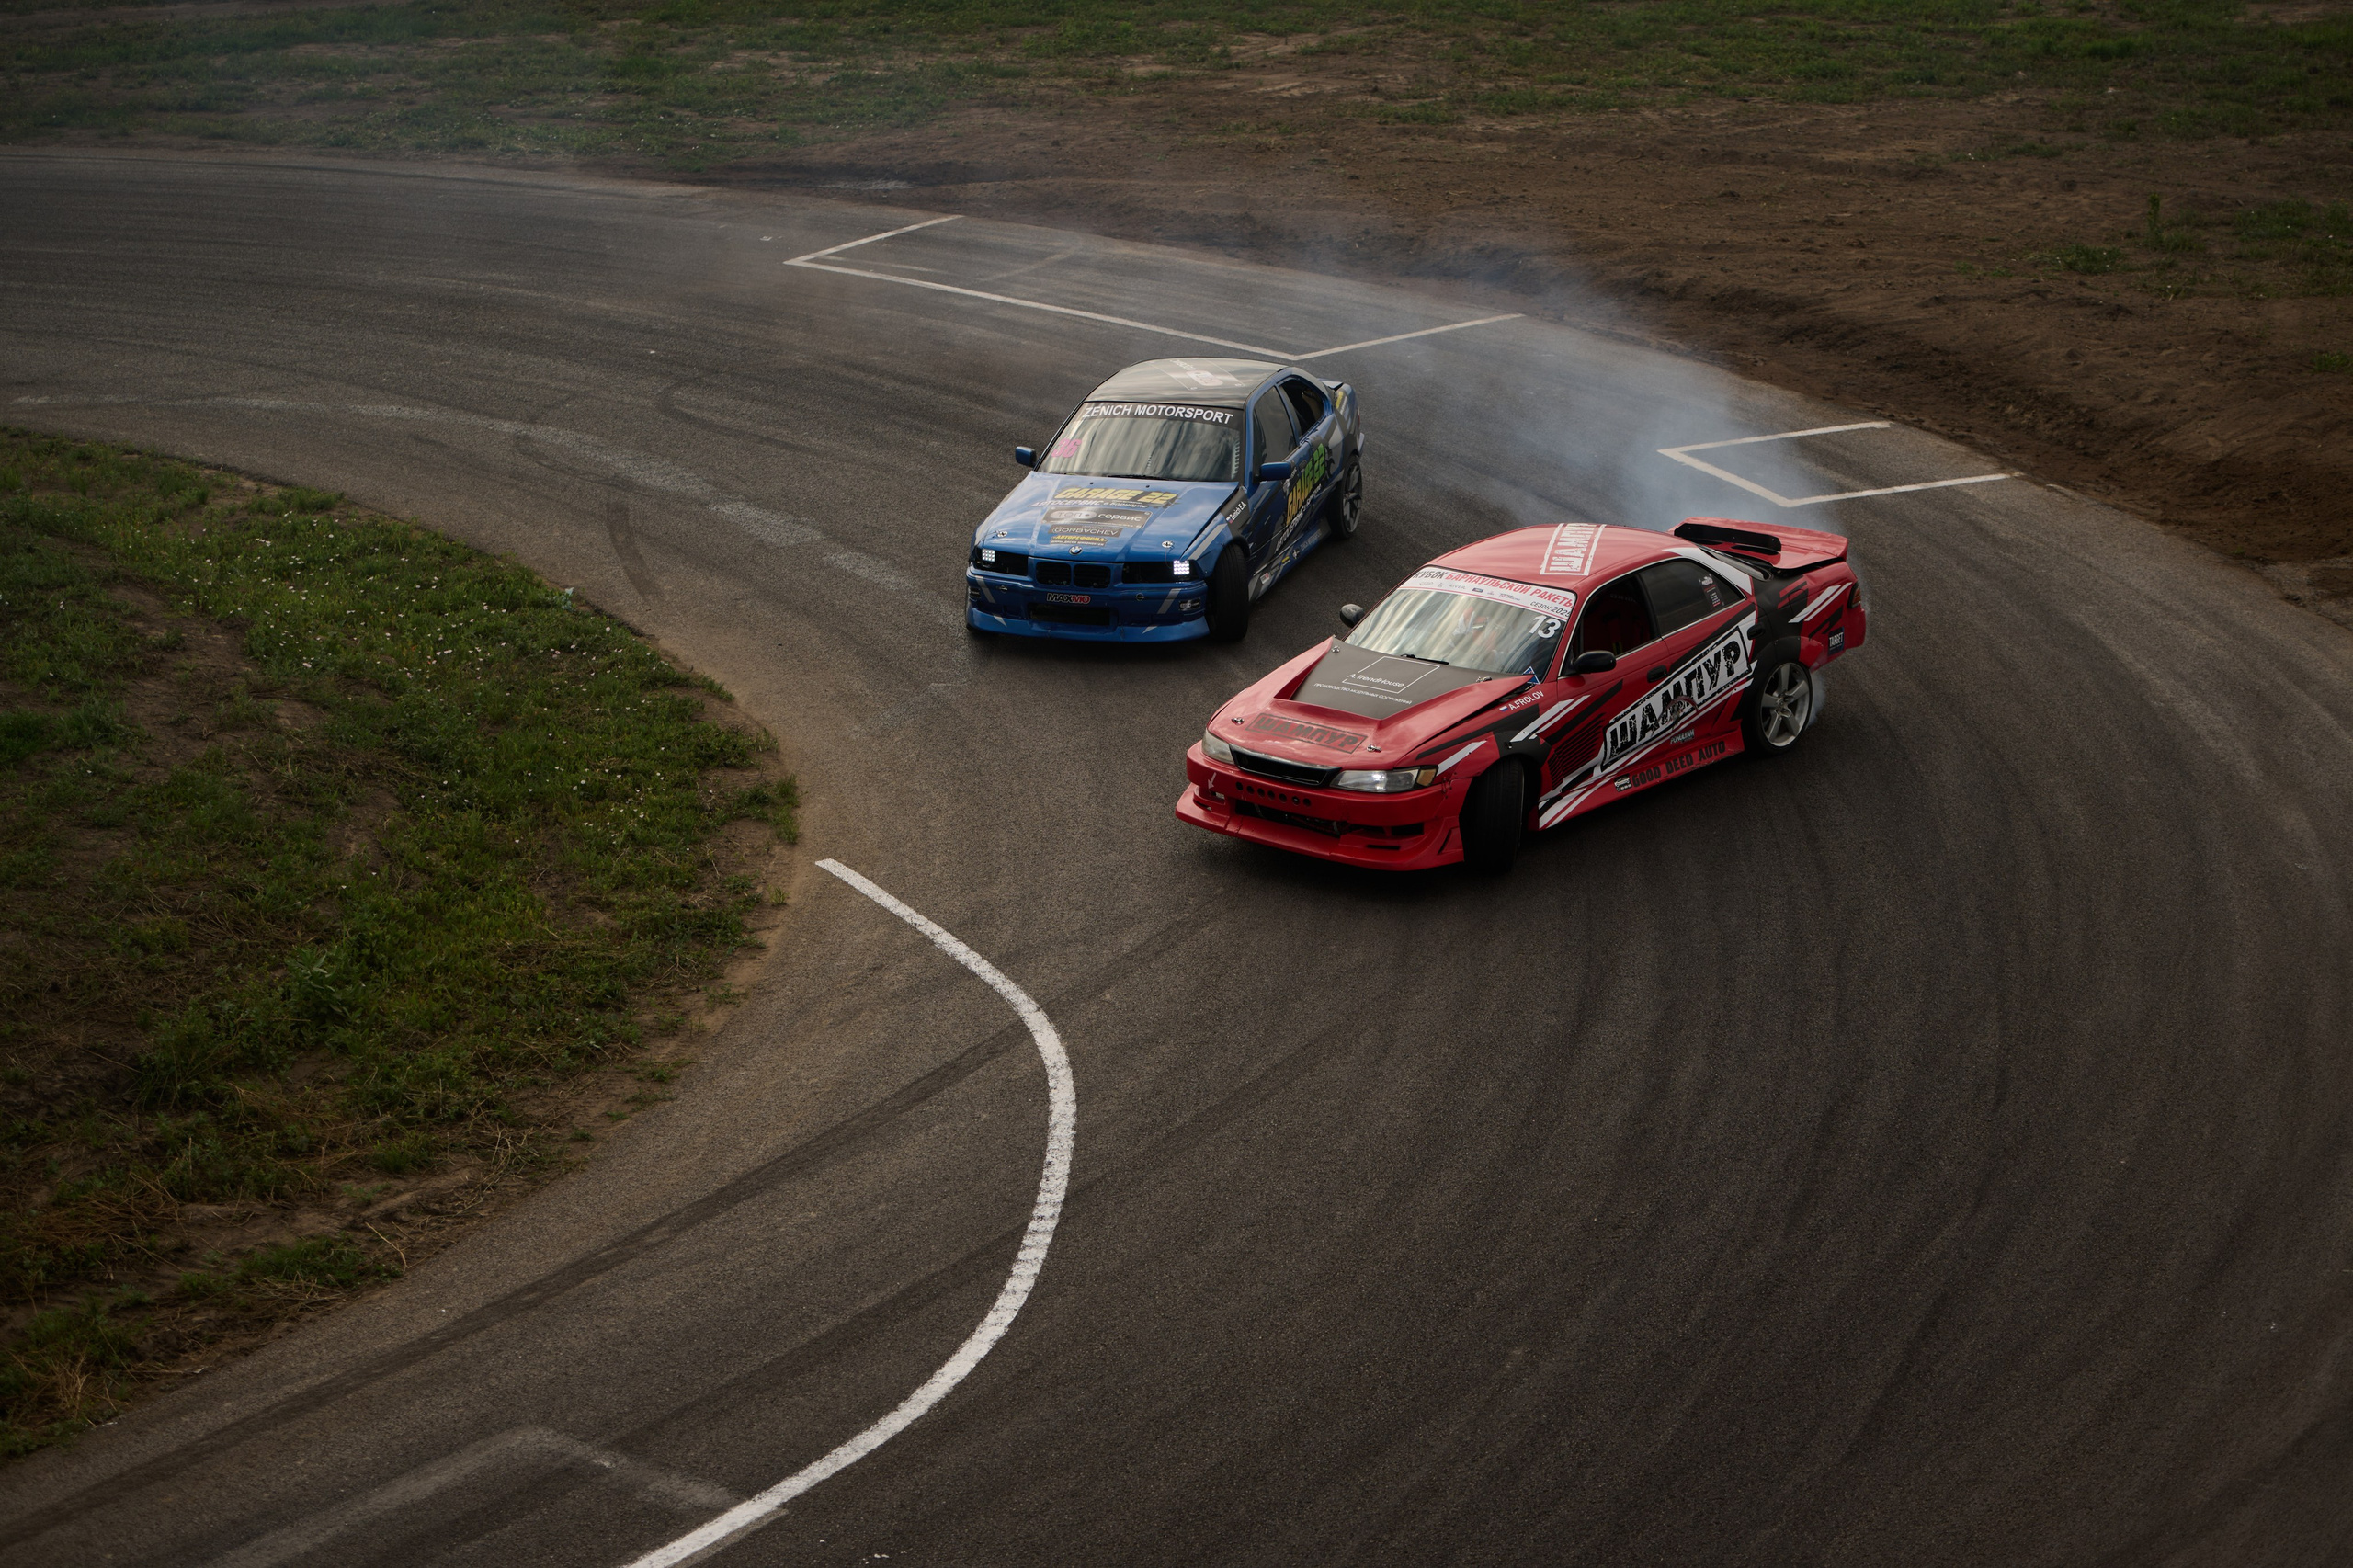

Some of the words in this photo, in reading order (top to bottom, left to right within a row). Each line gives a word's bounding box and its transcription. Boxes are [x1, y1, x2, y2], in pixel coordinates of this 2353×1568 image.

[1082, 404, 1133, 418] ZENICH
[1134, 404, 1234, 425] MOTORSPORT
[1051, 437, 1082, 458] 36
[1287, 458, 1313, 526] GARAGE
[1313, 442, 1325, 485] 22
[1029, 499, 1104, 507] АВТОСЕРВИС
[1054, 487, 1144, 501] GARAGE
[1137, 491, 1178, 505] 22
[1097, 513, 1142, 522] сервис
[1413, 571, 1448, 580] КУБОК
[1445, 573, 1532, 594] БАРНАУЛЬСКОЙ
[1047, 593, 1091, 604] MAXMO
[1530, 601, 1552, 610] СЕЗОН
[1551, 607, 1571, 617] 2025
[1529, 615, 1562, 639] 13
[1508, 690, 1544, 710] A.FROLOV
[1608, 641, 1741, 759] ШАМПУР
[1255, 717, 1359, 748] ШАМПУР
[1631, 766, 1662, 788] GOOD
[1665, 754, 1694, 775] DEED
[1699, 741, 1726, 762] AUTO
